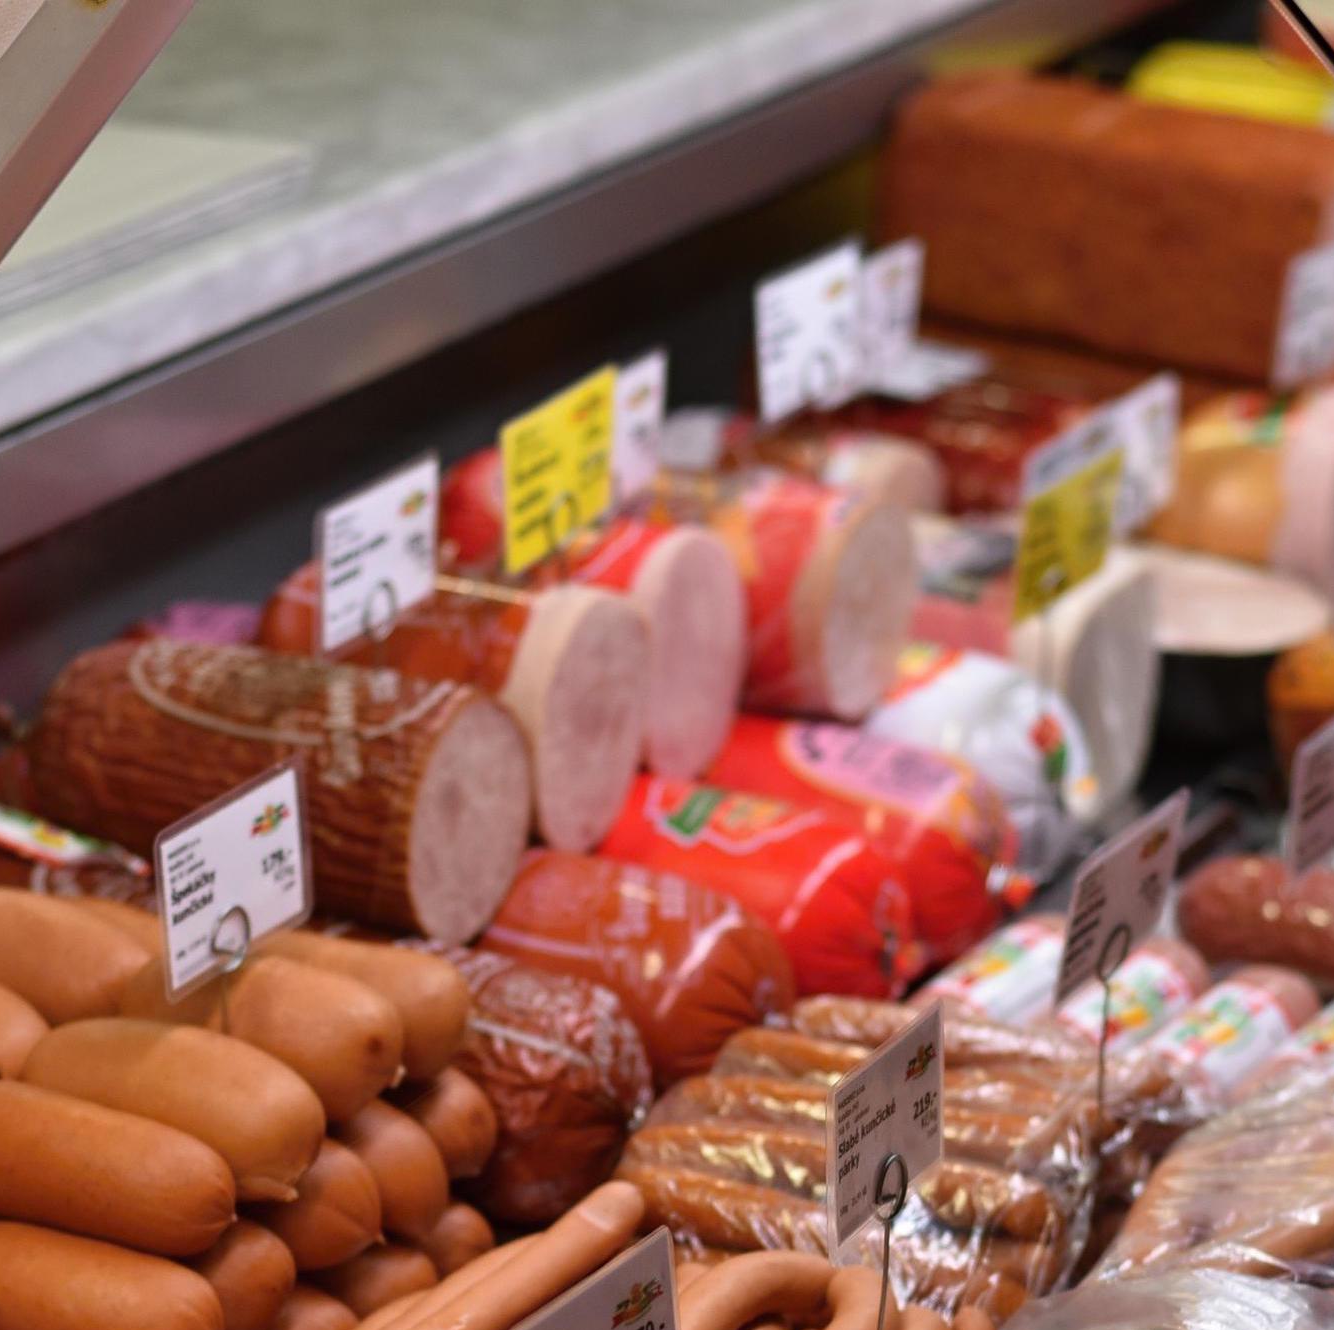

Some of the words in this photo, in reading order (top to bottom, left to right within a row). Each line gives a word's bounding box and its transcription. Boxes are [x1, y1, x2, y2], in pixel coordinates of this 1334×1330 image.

[838, 1125, 860, 1159] Slabé
[860, 1098, 896, 1142] kunčické
[838, 1152, 861, 1183] párky
